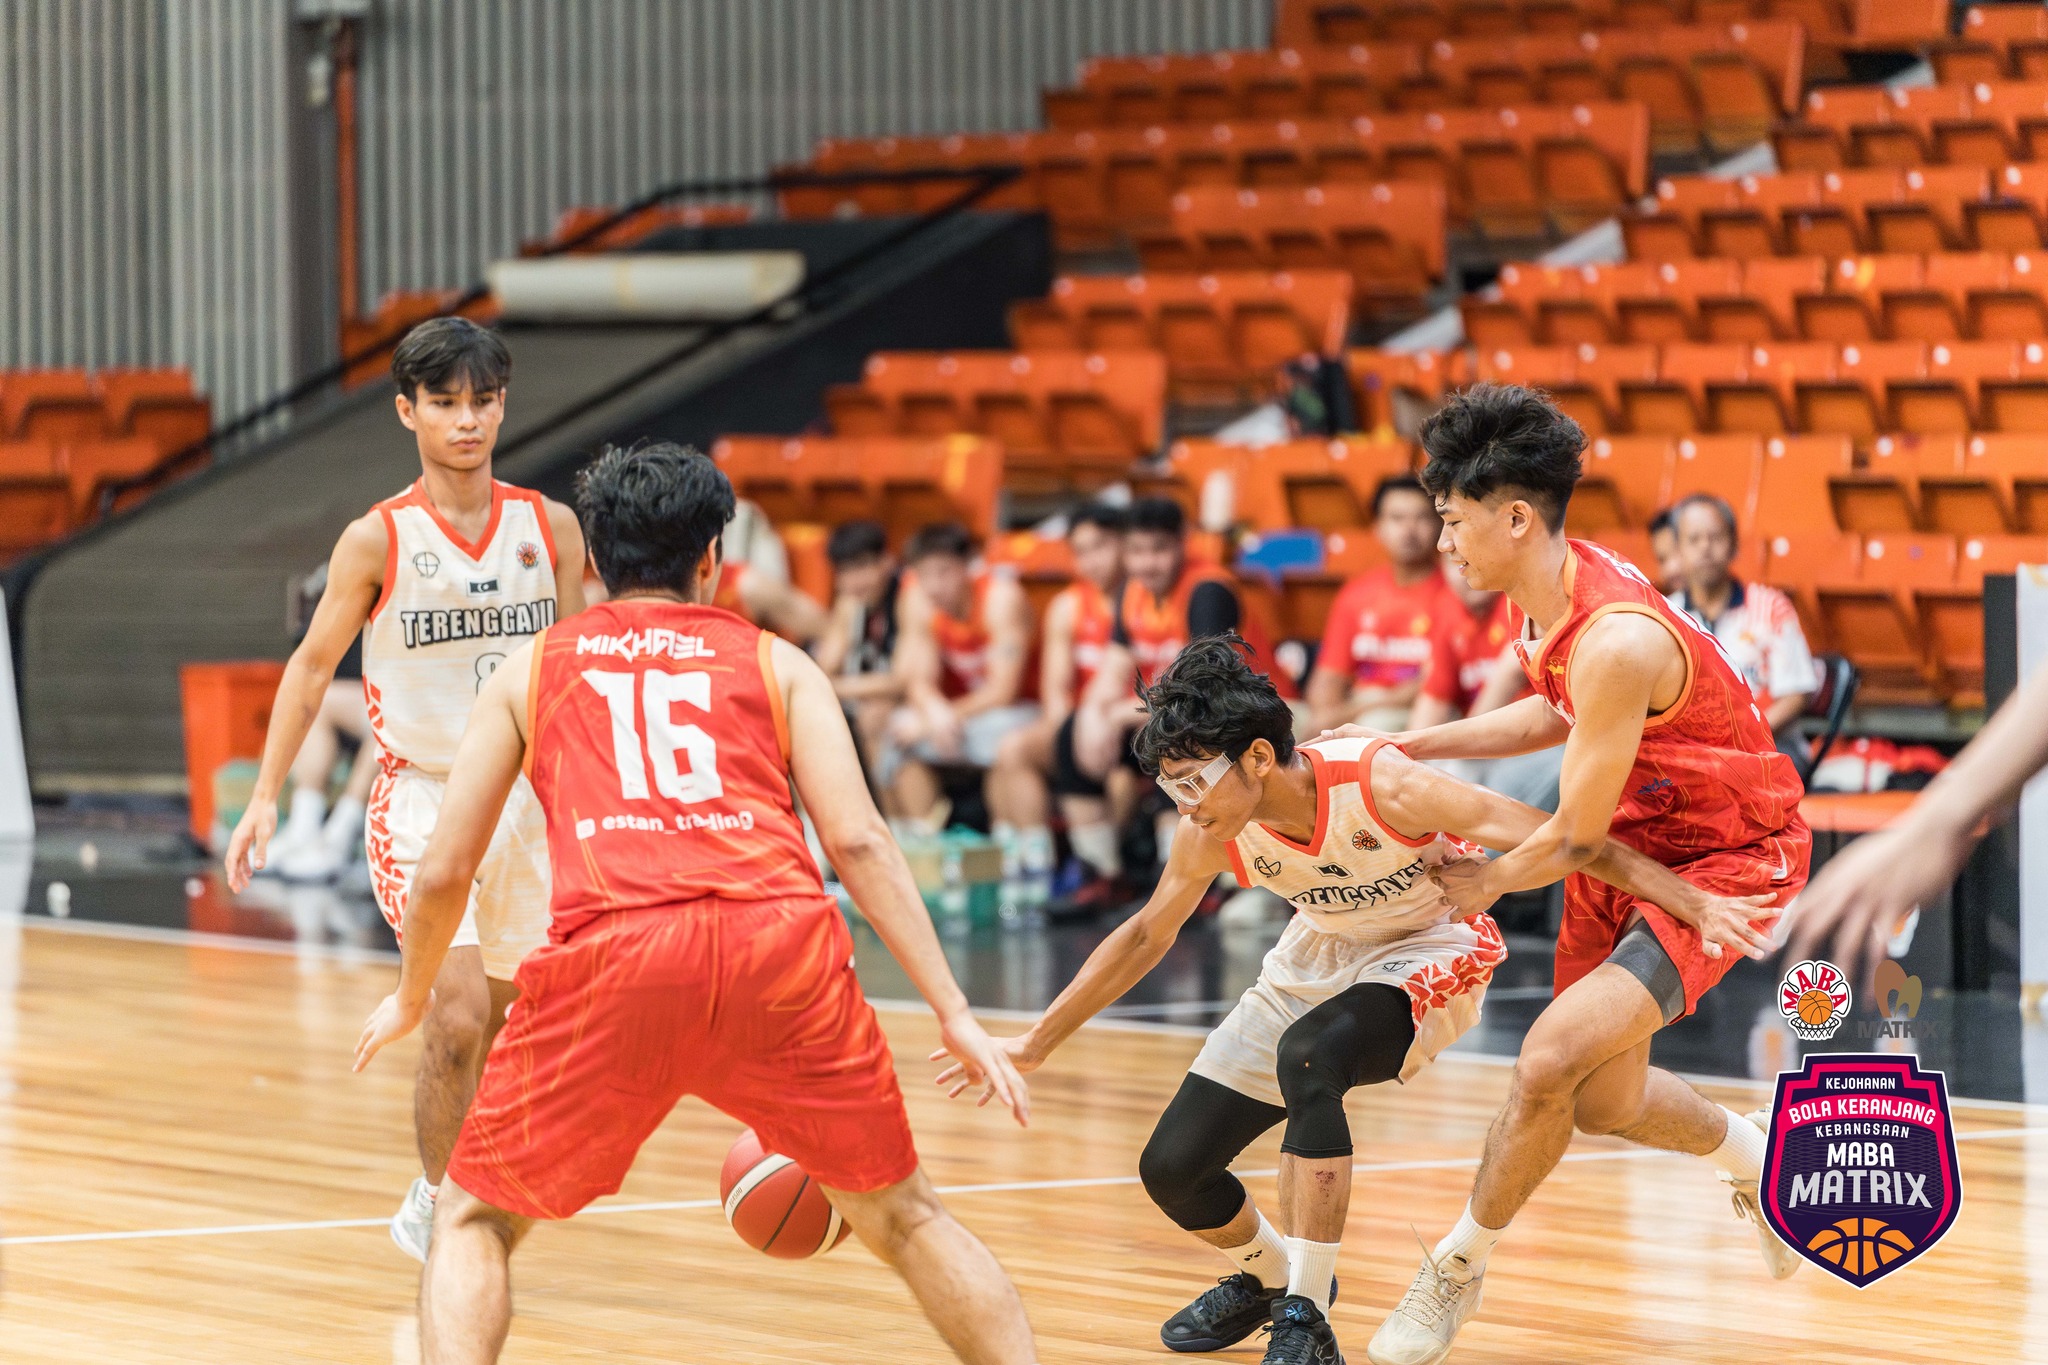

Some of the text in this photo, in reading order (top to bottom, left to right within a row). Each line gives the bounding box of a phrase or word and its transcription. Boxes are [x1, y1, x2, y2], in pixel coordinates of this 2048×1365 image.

[401, 598, 556, 649] TERENGGANU
[576, 627, 716, 663] MIKHAEL
[581, 669, 724, 804] 16
[602, 810, 755, 835] estan_trading
